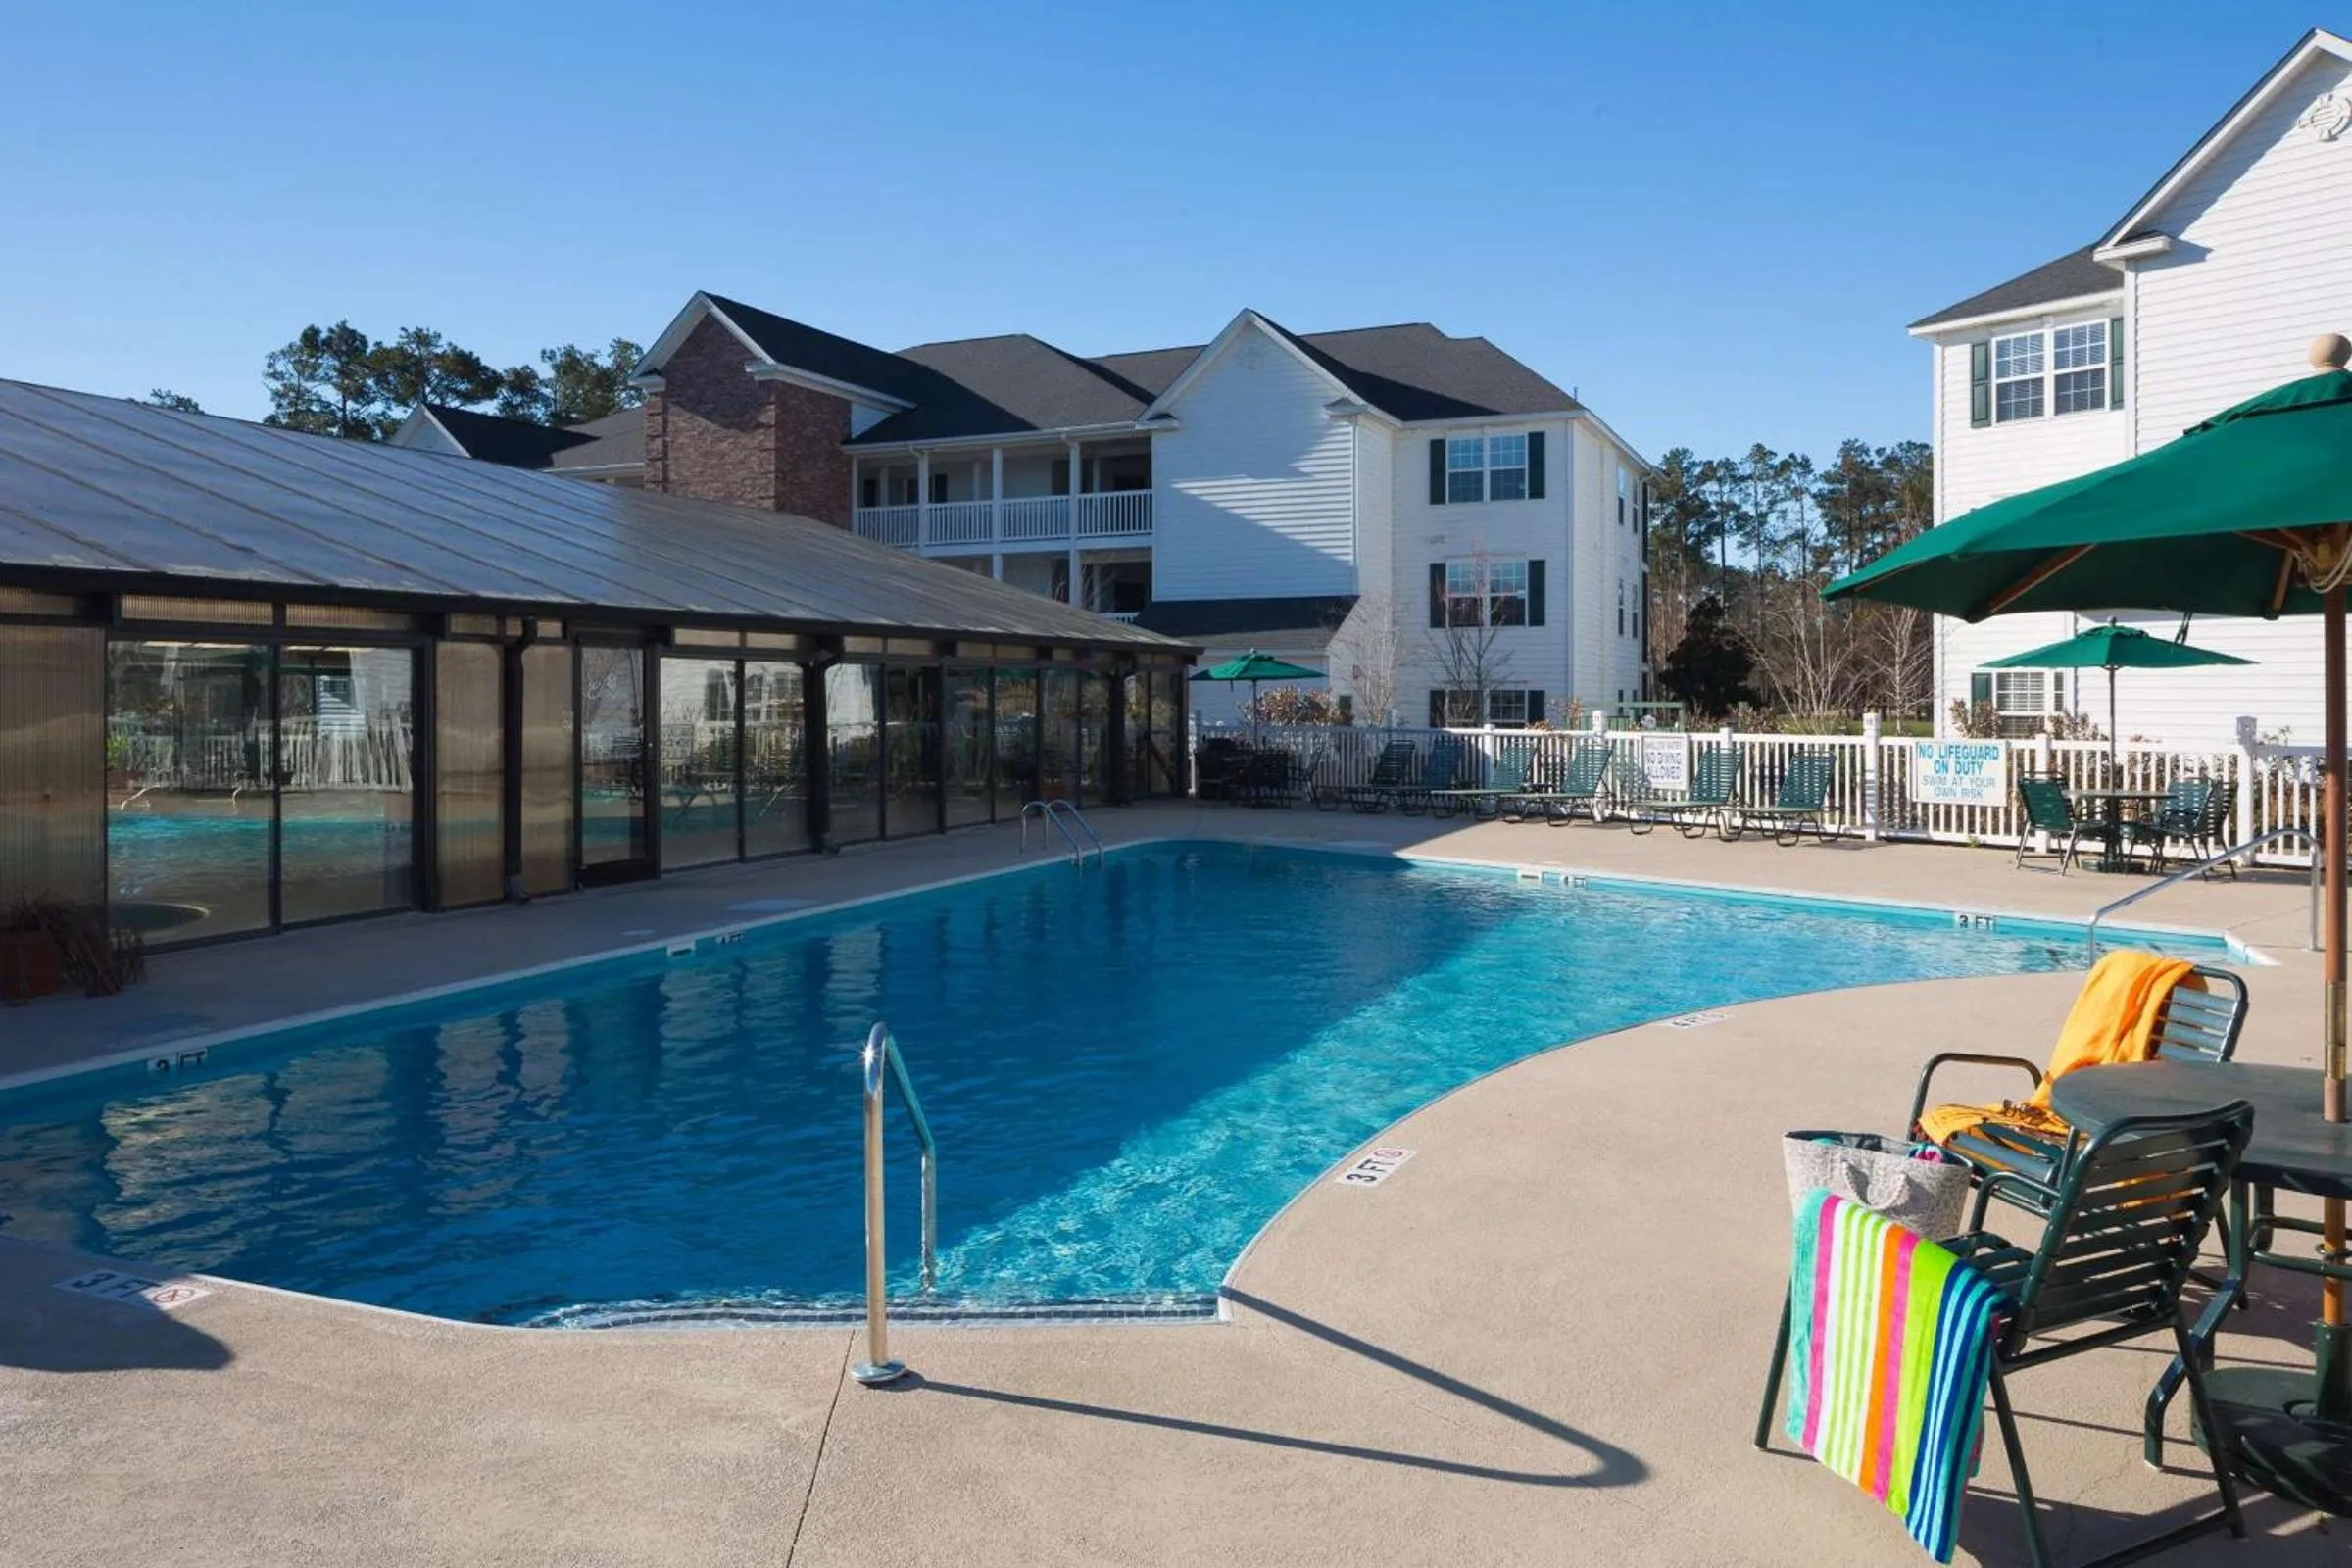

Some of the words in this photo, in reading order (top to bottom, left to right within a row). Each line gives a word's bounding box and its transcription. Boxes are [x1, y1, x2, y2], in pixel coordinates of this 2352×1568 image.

[1918, 744, 1934, 759] NO
[1939, 745, 2000, 760] LIFEGUARD
[1645, 765, 1682, 781] ALLOWED
[1934, 760, 1948, 774] ON
[1954, 760, 1984, 776] DUTY
[1922, 775, 1947, 787] SWIM
[1952, 776, 1964, 788] AT
[1970, 777, 1996, 789] YOUR
[1935, 787, 1957, 798] OWN
[1961, 788, 1984, 800] RISK
[1975, 916, 1992, 932] FT
[1357, 1158, 1395, 1172] FT
[1346, 1173, 1377, 1183] 3
[72, 1273, 117, 1289] 3
[97, 1278, 162, 1298] FT
